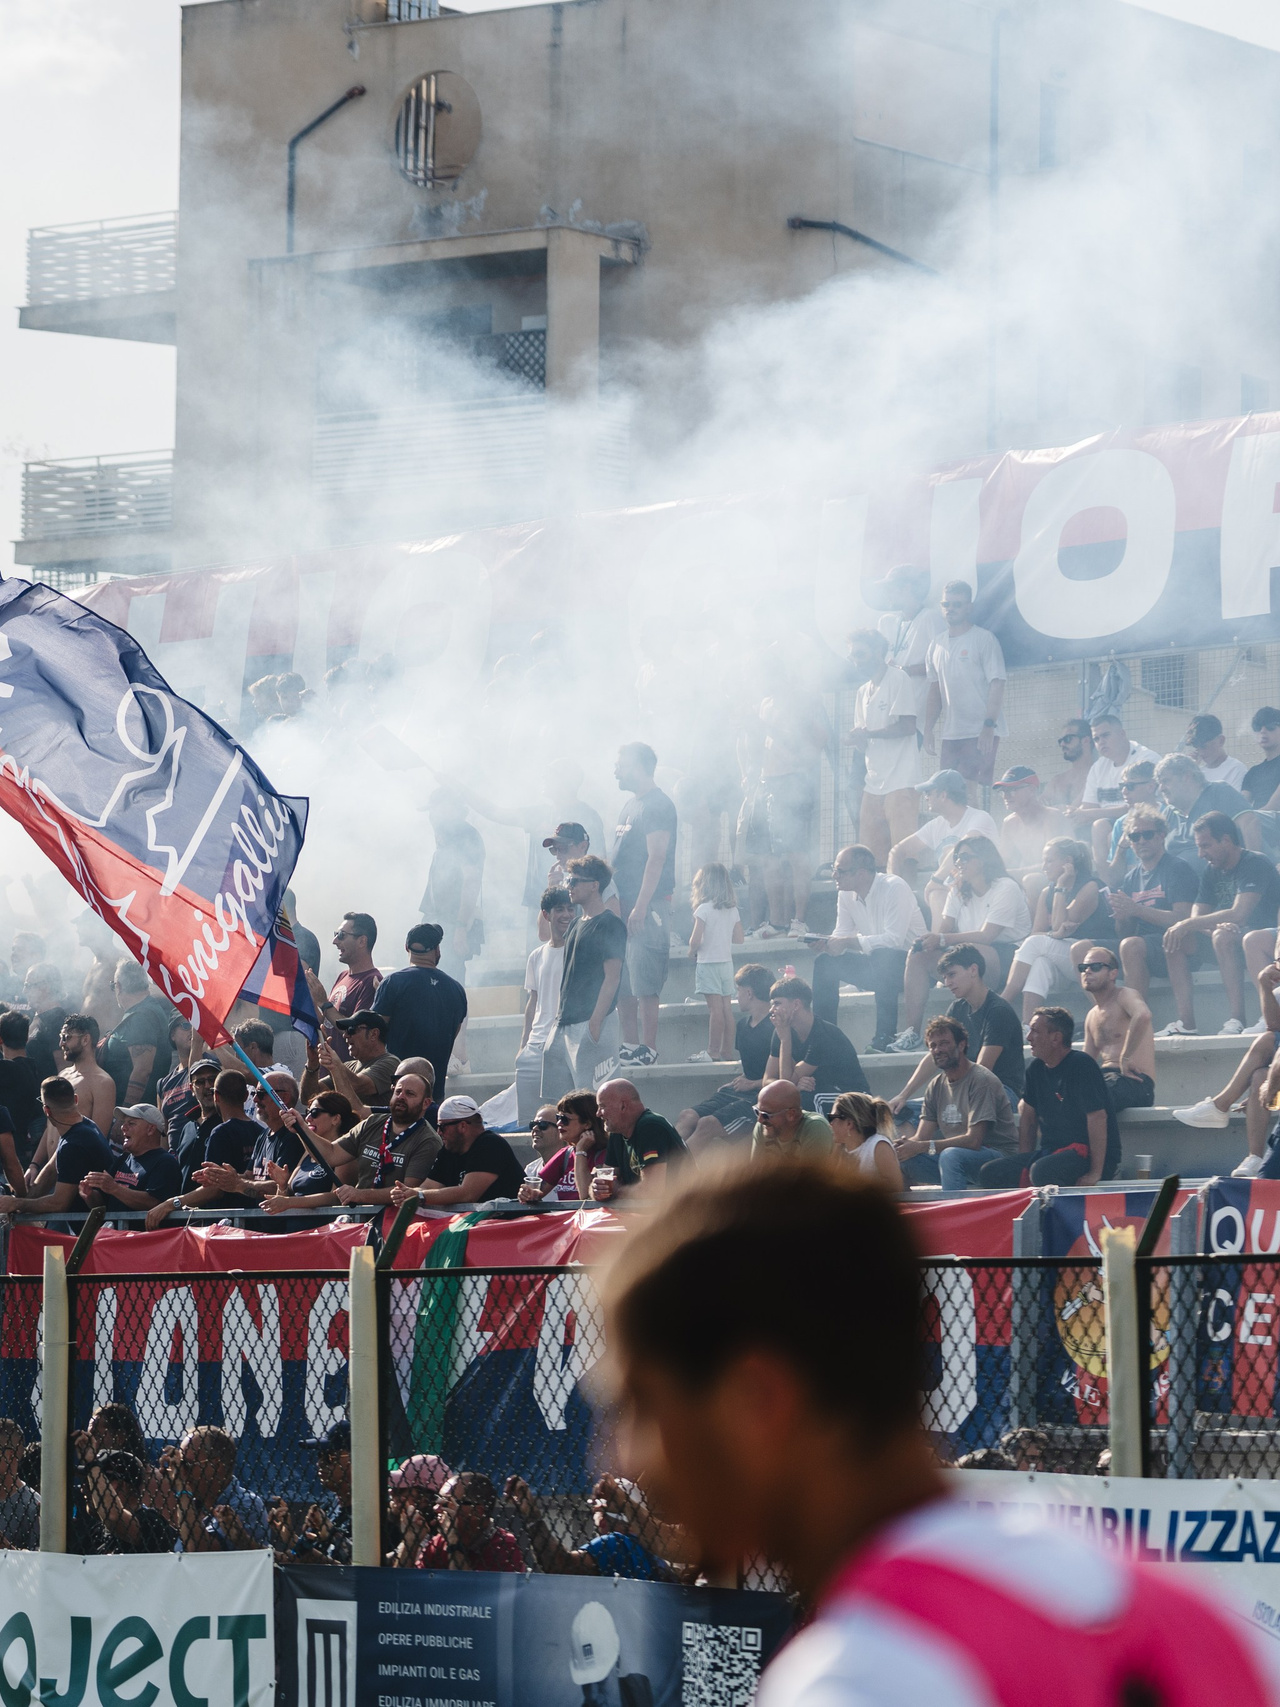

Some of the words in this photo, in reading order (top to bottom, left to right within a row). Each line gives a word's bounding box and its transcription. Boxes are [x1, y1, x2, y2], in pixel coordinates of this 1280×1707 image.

[594, 1056, 615, 1078] NIKE
[379, 1601, 421, 1615] EDILIZIA
[424, 1603, 492, 1618] INDUSTRIALE
[378, 1633, 412, 1646] OPERE
[415, 1634, 474, 1649] PUBBLICHE
[378, 1664, 427, 1678] IMPIANTI
[429, 1666, 448, 1679] OIL
[450, 1667, 457, 1680] E
[459, 1668, 480, 1681] GAS
[378, 1695, 422, 1707] EDILIZIA
